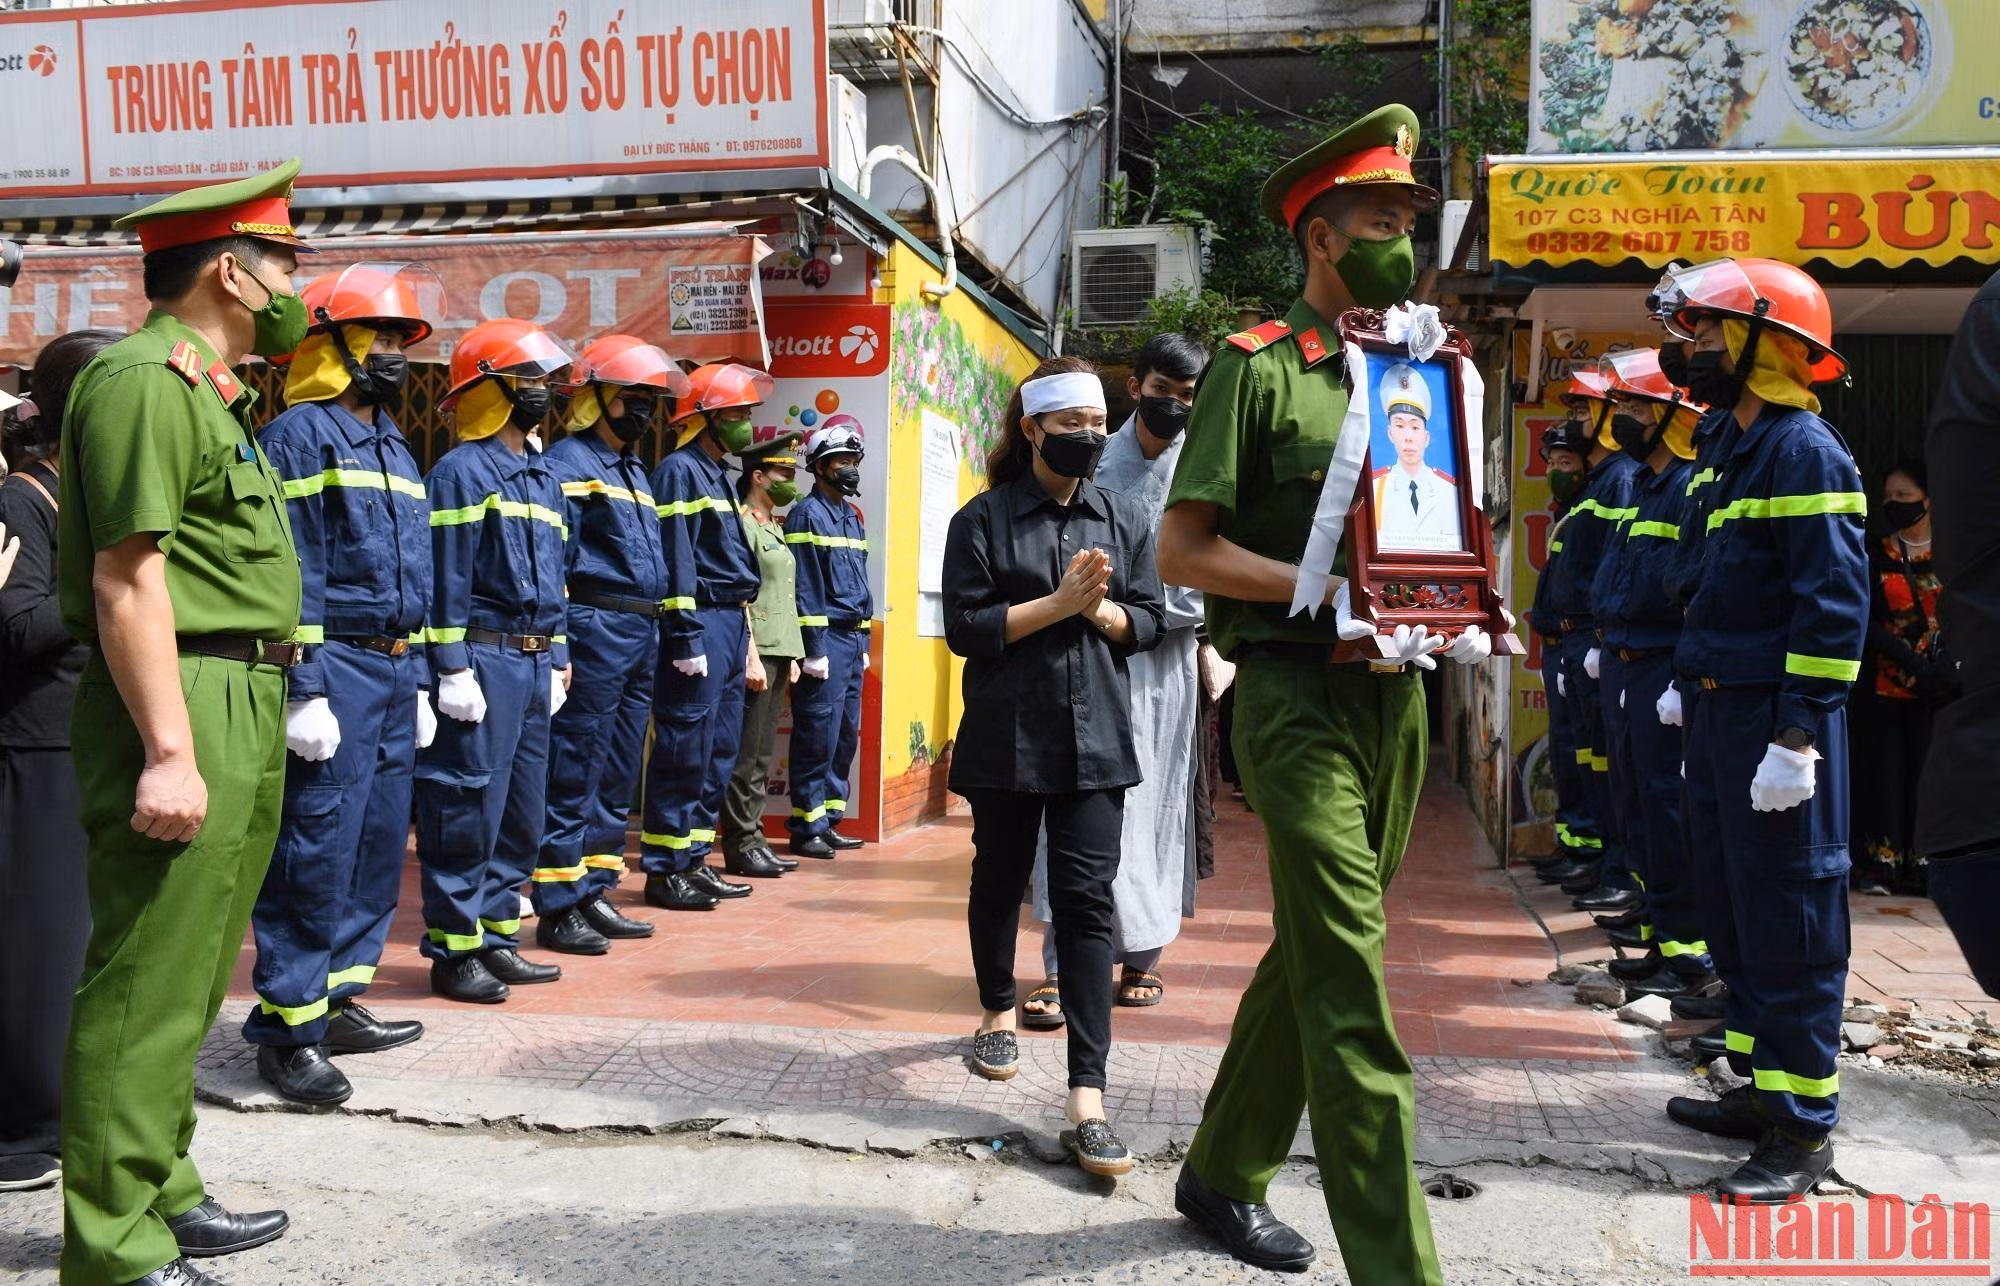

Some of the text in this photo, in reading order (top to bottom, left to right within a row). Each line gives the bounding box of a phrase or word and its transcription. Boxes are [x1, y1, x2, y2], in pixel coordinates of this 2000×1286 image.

[107, 9, 792, 133] TRUNG TÂM TRẢ THƯỞNG XỔ SỐ TỰ CHỌN
[1979, 97, 2000, 119] C
[624, 145, 639, 157] ĐẠI
[642, 142, 653, 155] LÝ
[656, 141, 675, 154] ĐỨC
[726, 140, 740, 152] ĐT:
[743, 138, 802, 152] 0976208868
[1510, 166, 1621, 204] Quốc
[1514, 203, 1765, 226] 107 C3 NGHĨA TÂN
[1527, 230, 1750, 253] 0332 607 758
[671, 265, 752, 283] PHÚ THÀN
[690, 284, 702, 296] MÁI
[723, 284, 735, 296] MÁI
